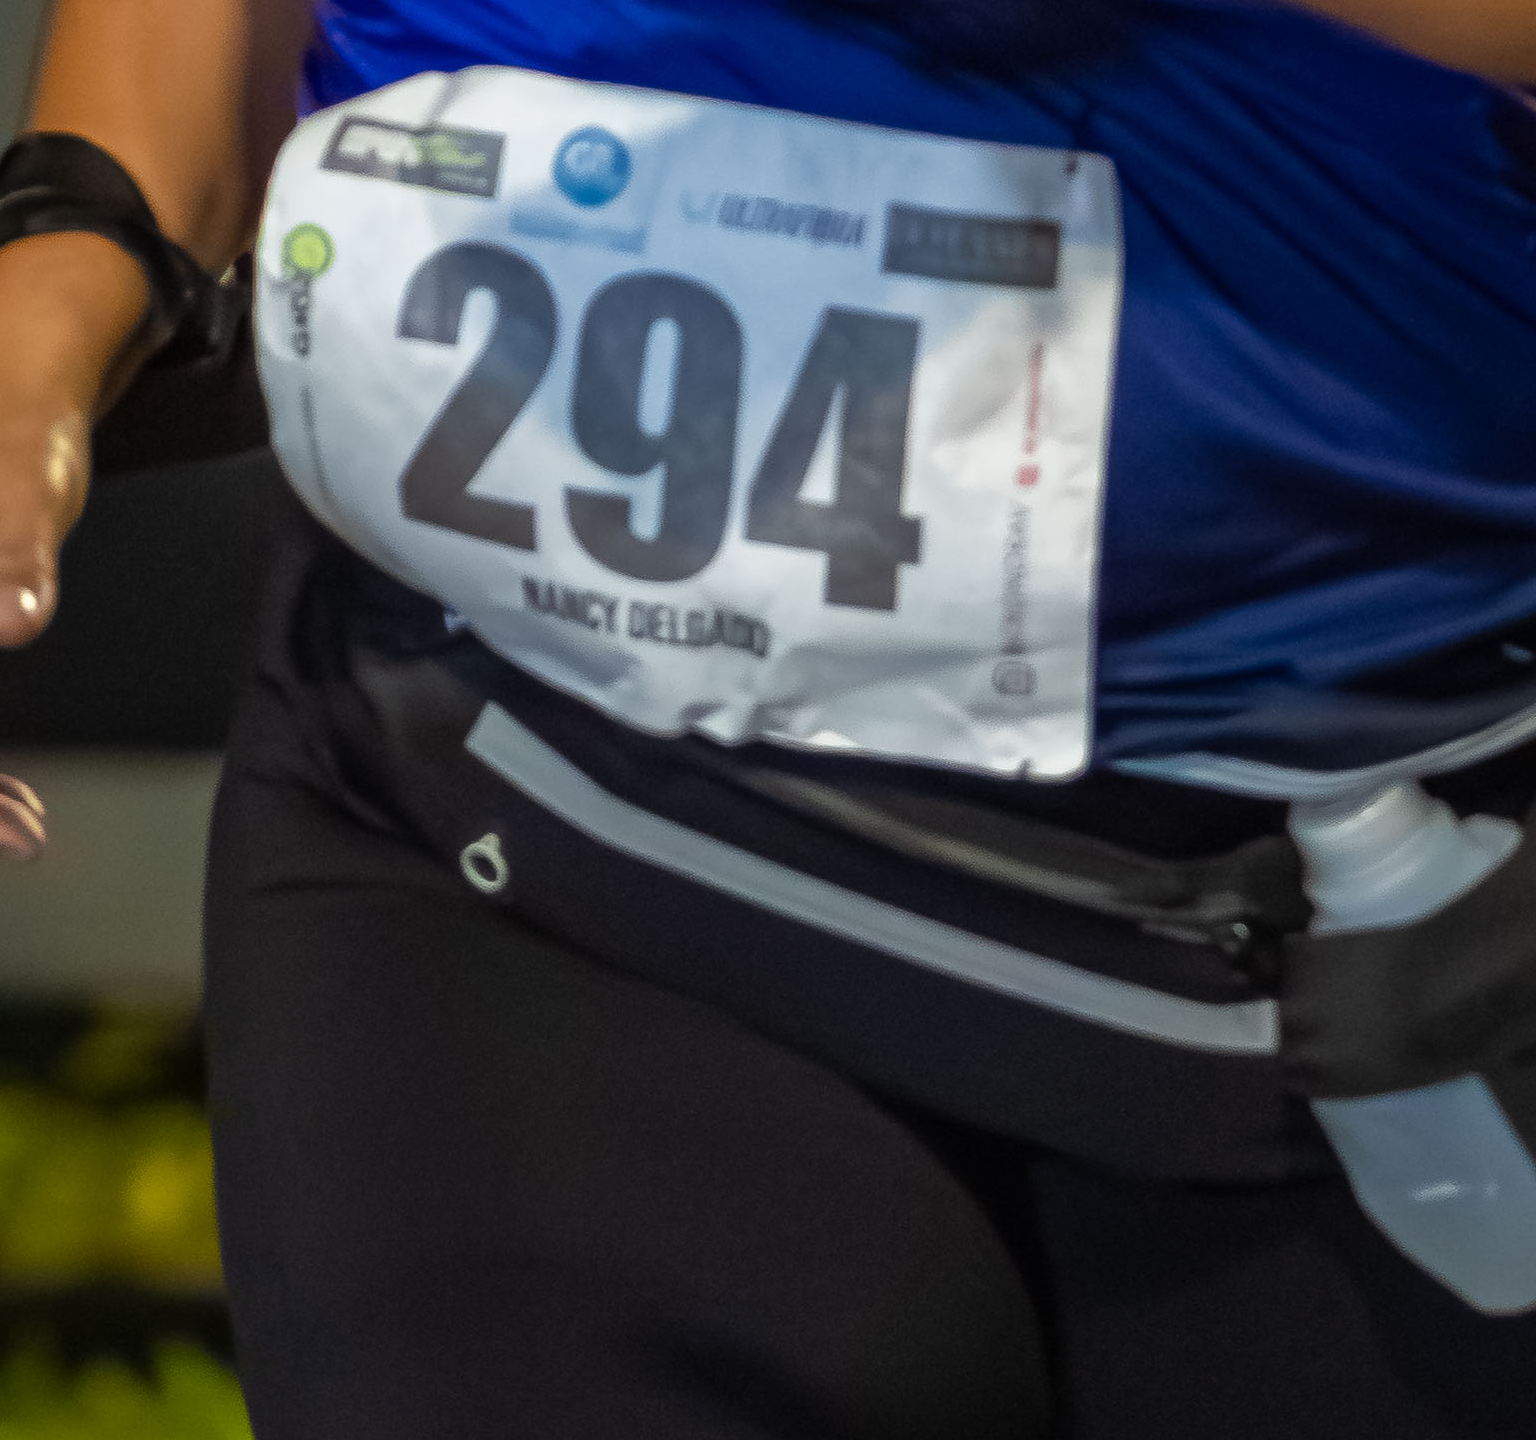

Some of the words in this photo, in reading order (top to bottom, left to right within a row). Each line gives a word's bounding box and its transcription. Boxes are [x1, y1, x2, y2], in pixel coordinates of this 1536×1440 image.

[396, 240, 924, 614] 294
[520, 573, 621, 639] NANCY
[627, 600, 772, 660] DELGADO
